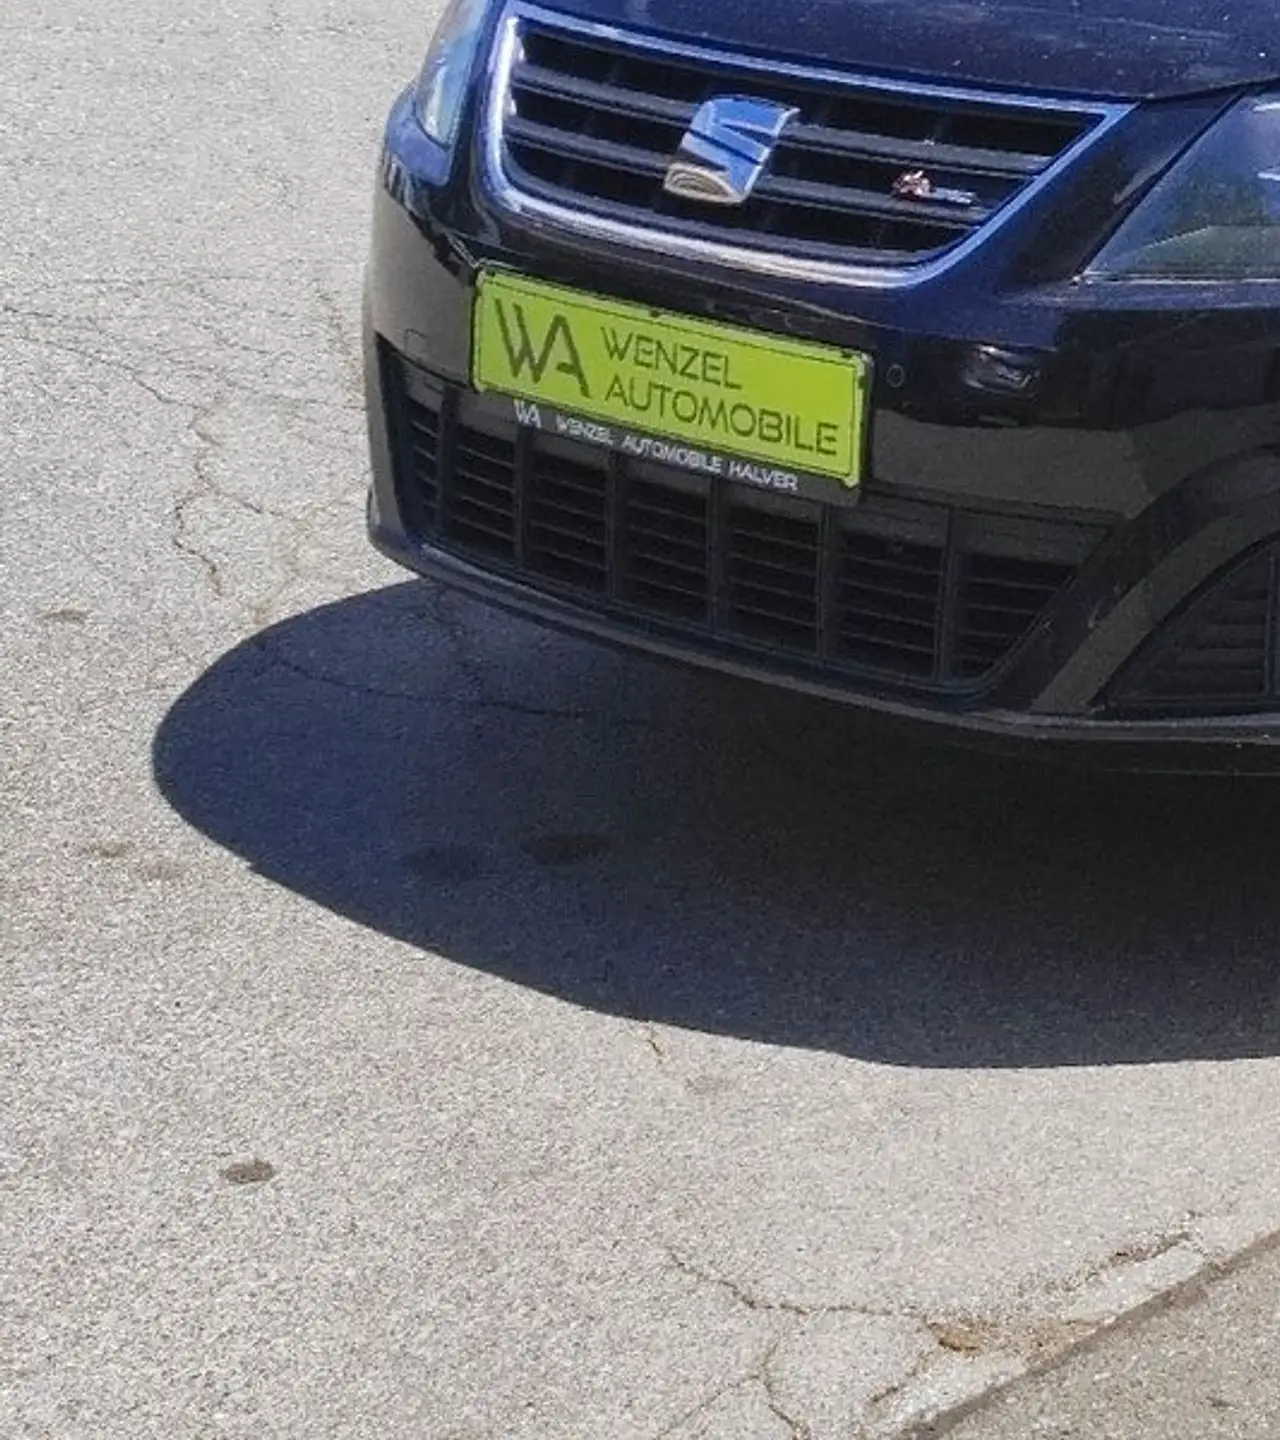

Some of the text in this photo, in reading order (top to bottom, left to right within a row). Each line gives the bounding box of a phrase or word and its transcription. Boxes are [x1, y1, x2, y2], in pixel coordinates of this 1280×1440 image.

[494, 297, 592, 399] WA
[600, 325, 742, 390] WENZEL
[513, 398, 799, 492] WA WENZEL AUTOMOBILE HALVER
[604, 373, 840, 456] AUTOMOBILE
